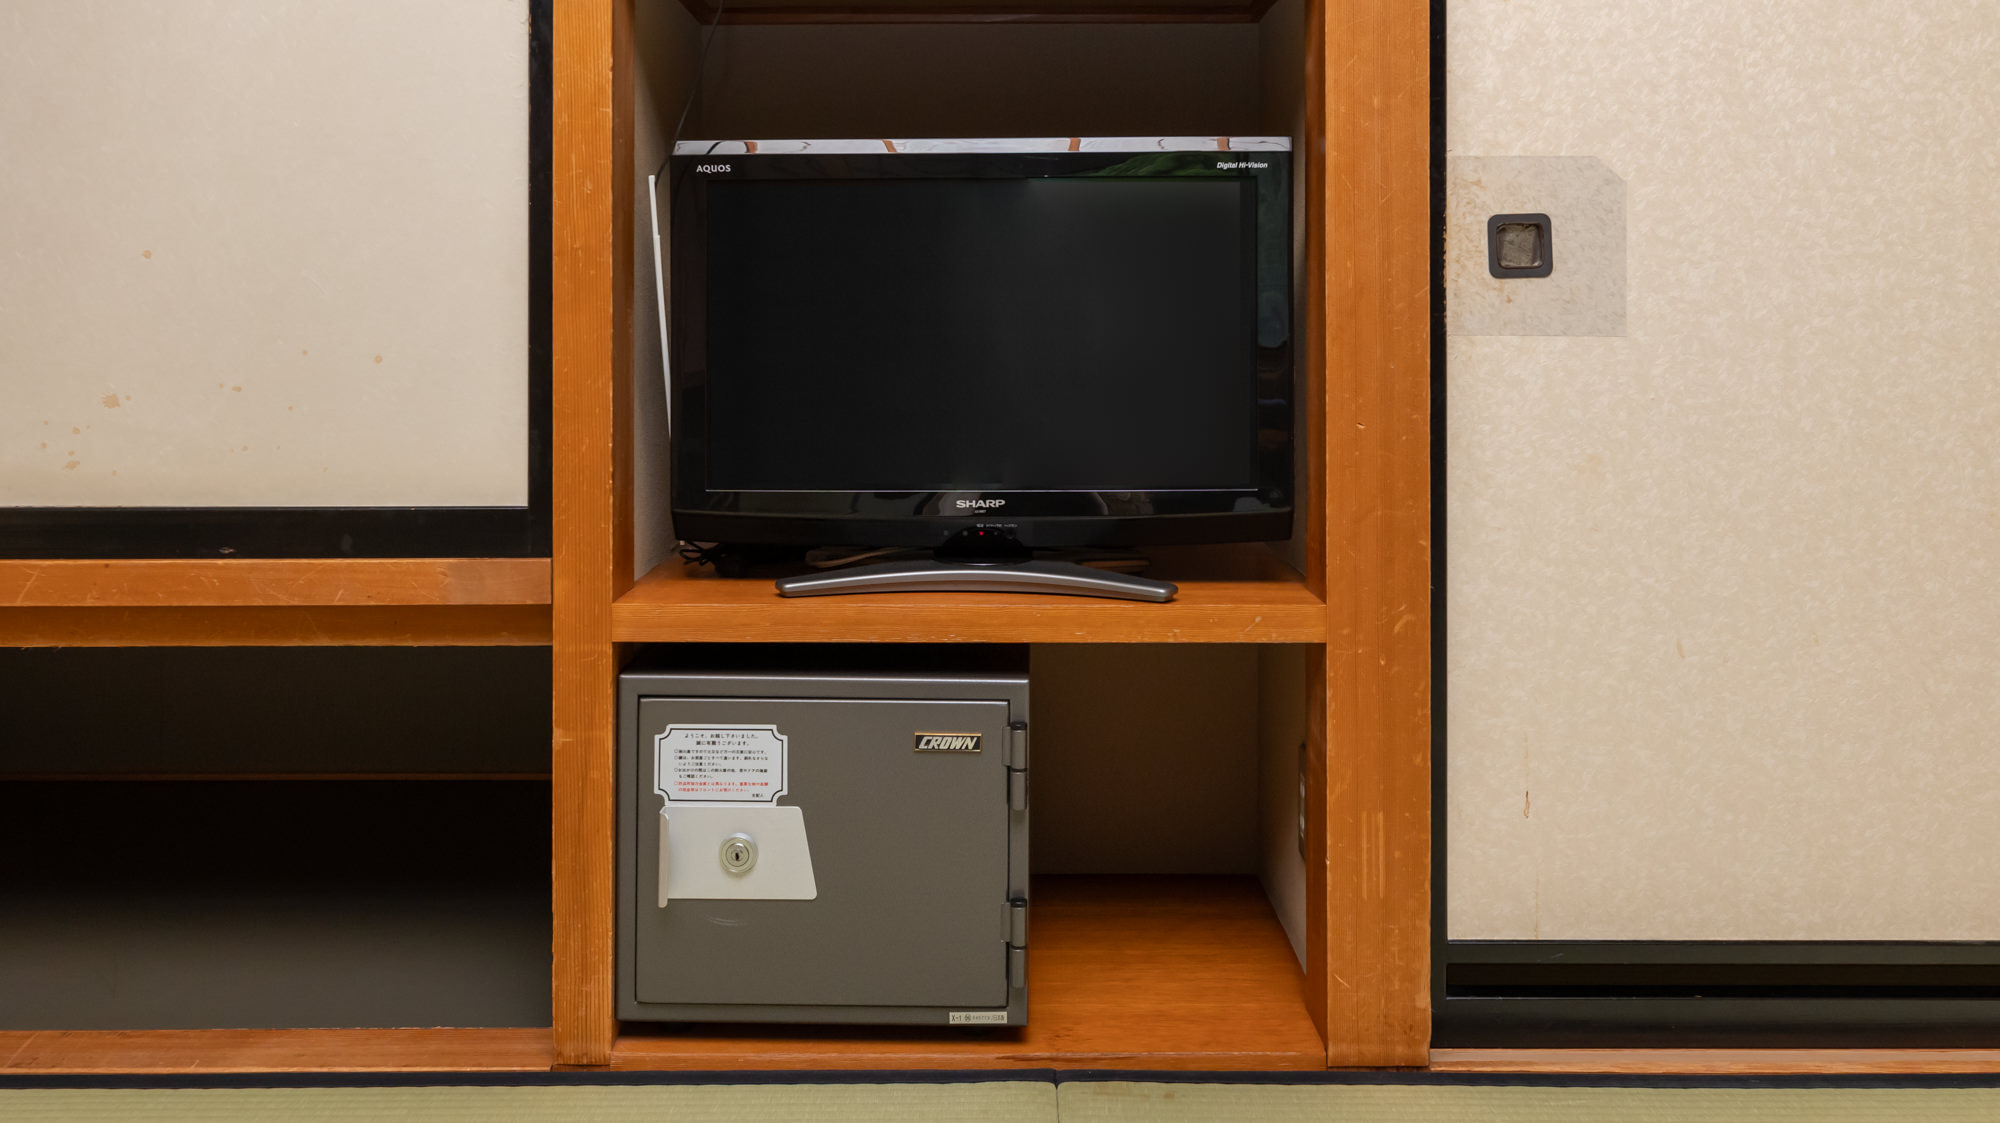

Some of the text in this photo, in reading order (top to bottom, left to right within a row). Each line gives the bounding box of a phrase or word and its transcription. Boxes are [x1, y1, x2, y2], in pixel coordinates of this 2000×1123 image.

[696, 164, 732, 174] AQUOS
[1216, 161, 1268, 170] Digital Hi-Vision
[955, 499, 1006, 508] SHARP
[918, 736, 978, 750] CROWN
